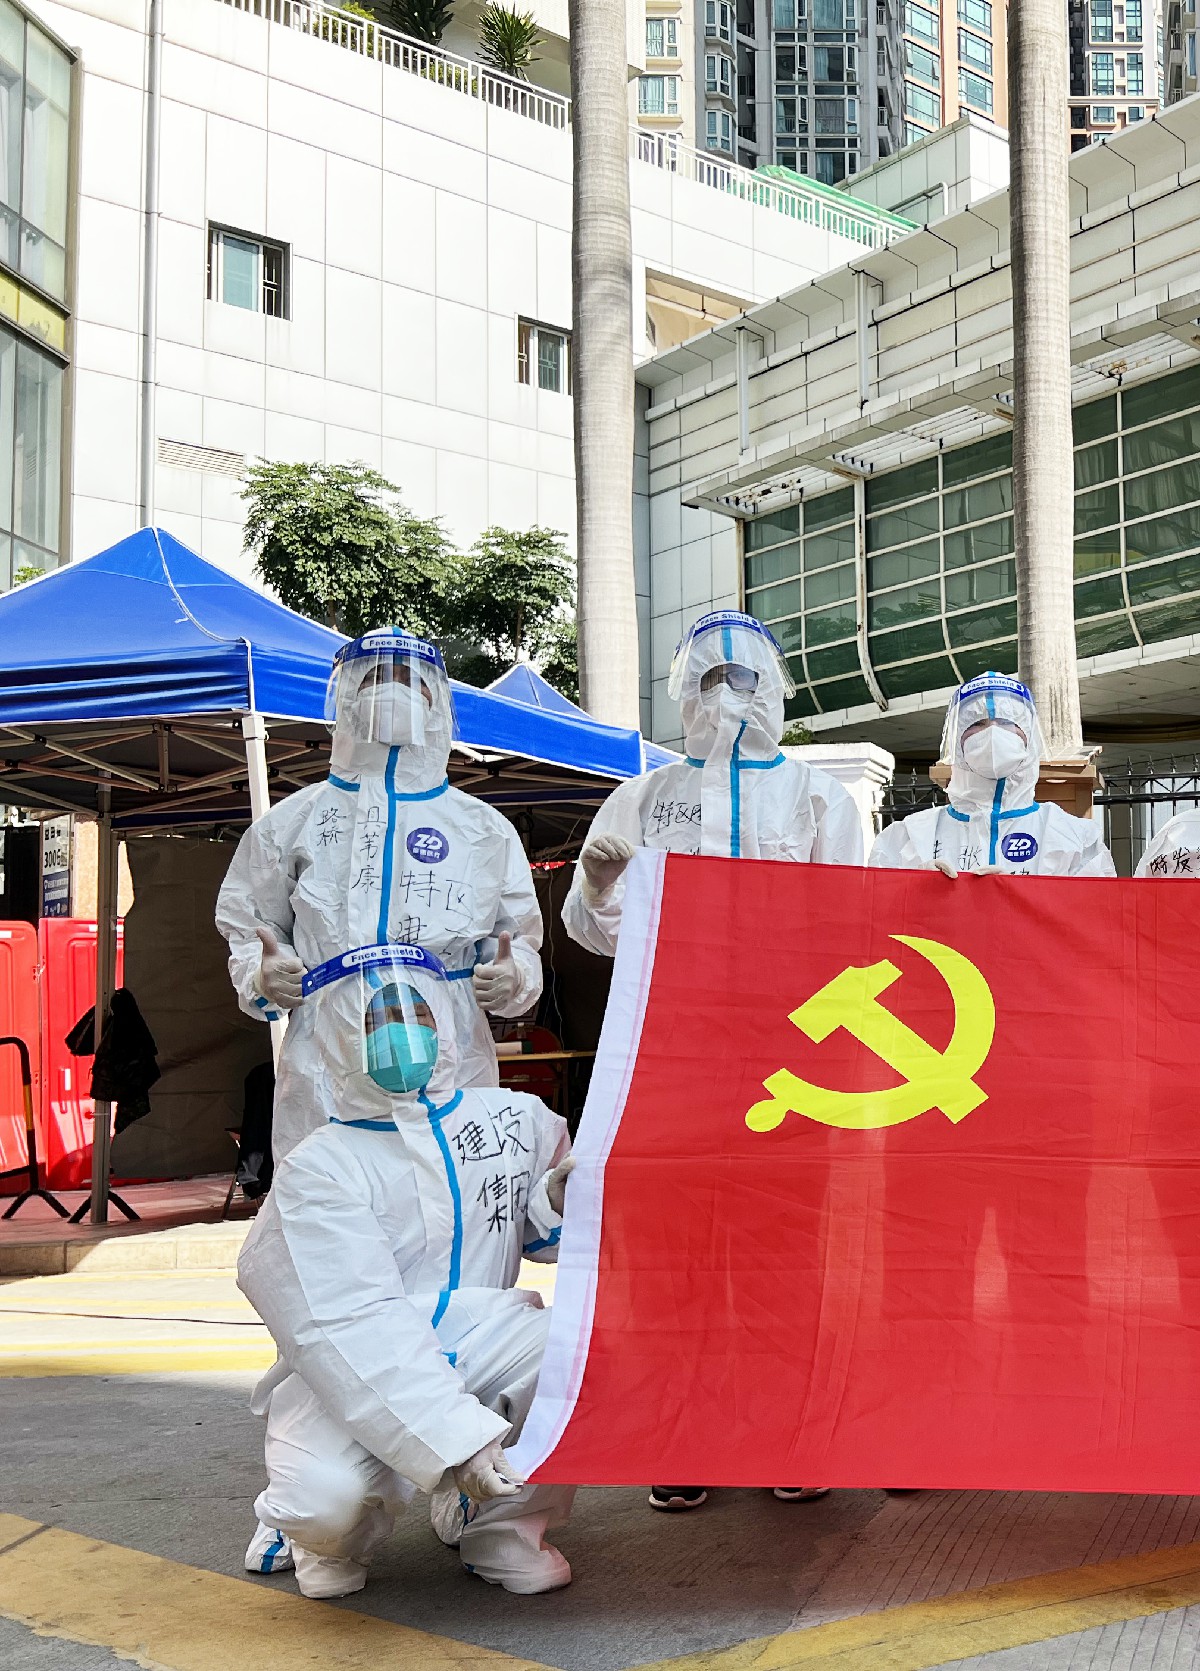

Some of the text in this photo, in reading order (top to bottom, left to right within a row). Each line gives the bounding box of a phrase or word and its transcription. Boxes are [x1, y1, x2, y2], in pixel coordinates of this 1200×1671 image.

[395, 639, 426, 651] Shield
[414, 833, 443, 850] ZD
[1007, 838, 1032, 851] ZD
